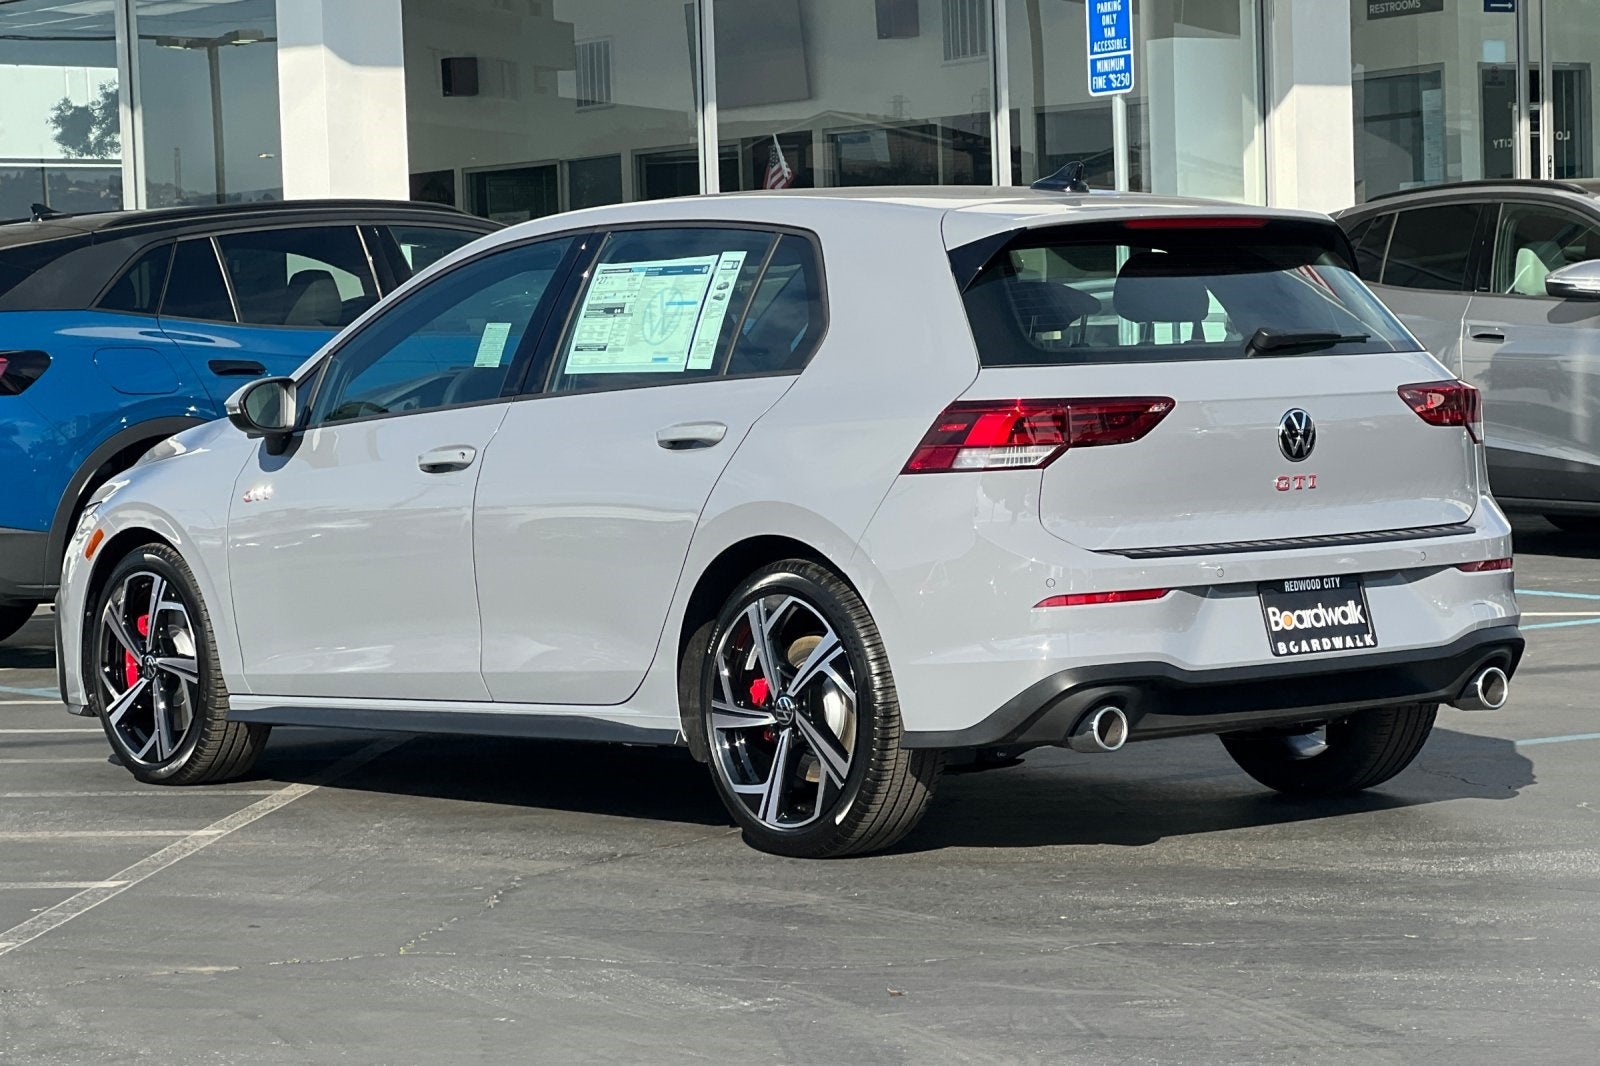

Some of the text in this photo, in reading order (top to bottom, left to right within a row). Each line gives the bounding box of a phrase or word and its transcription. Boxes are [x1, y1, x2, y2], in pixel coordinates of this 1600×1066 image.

[1096, 0, 1122, 14] PARKING
[1369, 0, 1421, 14] RESTROOMS
[1101, 13, 1117, 26] ONLY
[1103, 27, 1116, 38] VAN
[1093, 37, 1128, 52] ACCESSIBLE
[1096, 57, 1125, 73] MINIMUM
[1092, 75, 1107, 90] FINE
[1275, 474, 1317, 491] GTI
[1284, 577, 1341, 592] REDWOOD CITY
[1267, 600, 1366, 632] Boardwalk
[1277, 634, 1375, 655] BOARDWALK
